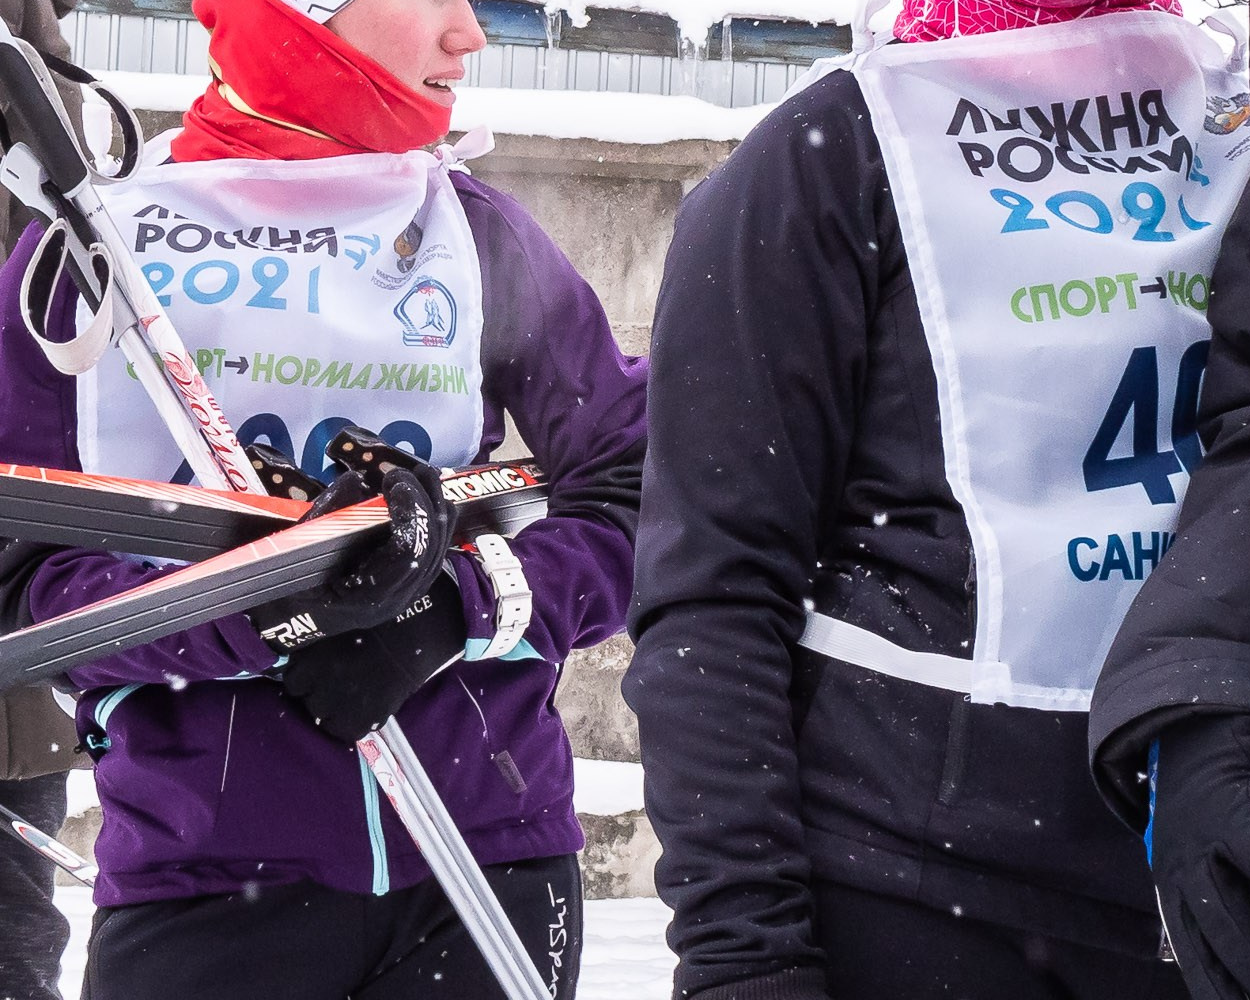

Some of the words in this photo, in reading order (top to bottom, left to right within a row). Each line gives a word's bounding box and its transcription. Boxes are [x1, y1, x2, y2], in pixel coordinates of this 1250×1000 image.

[140, 255, 320, 315] 2021
[1010, 273, 1139, 323] СПОРТ
[1168, 271, 1212, 311] НО
[251, 352, 374, 391] НОРМА
[372, 363, 469, 396] ЖИЗНИ
[441, 467, 525, 501] ATOMIC
